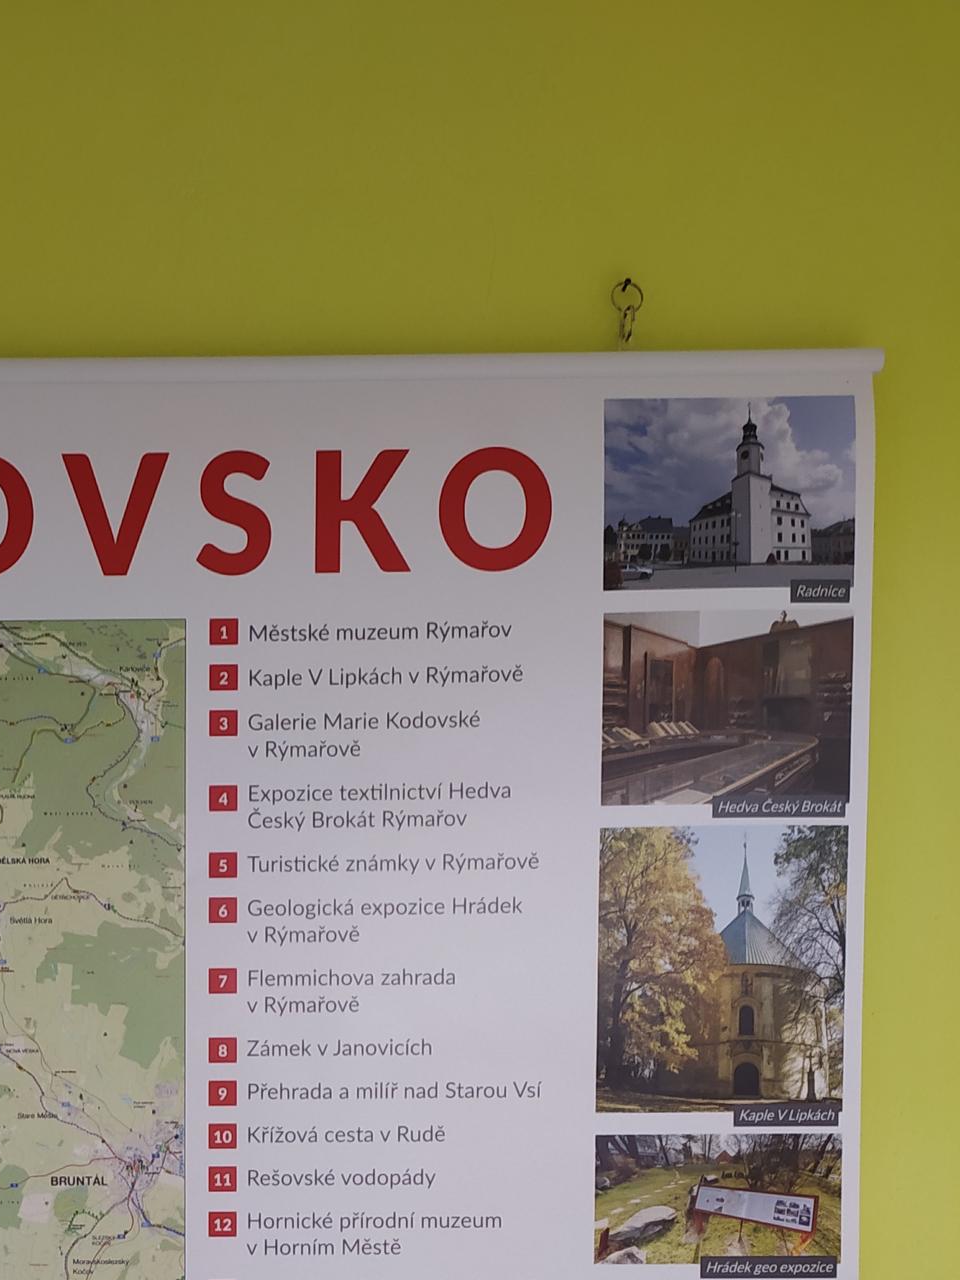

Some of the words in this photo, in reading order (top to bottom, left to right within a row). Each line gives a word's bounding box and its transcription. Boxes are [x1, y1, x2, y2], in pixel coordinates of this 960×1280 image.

[797, 585, 845, 597] Radnice
[250, 624, 329, 641] Městské
[337, 627, 418, 640] muzeum
[427, 621, 511, 642] Rýmařov
[250, 669, 302, 690] Kaple
[309, 669, 322, 685] V
[330, 667, 401, 688] Lipkách
[409, 672, 419, 684] v
[427, 665, 523, 687] Rýmařově
[248, 713, 316, 731] Galerie
[324, 712, 378, 729] Marie
[387, 710, 480, 729] Kodovské
[249, 784, 332, 805] Expozice
[340, 783, 442, 800] textilnictví
[450, 782, 510, 799] Hedva
[719, 801, 758, 814] Hedva
[762, 800, 800, 815] Český
[801, 801, 842, 814] Brokát
[248, 808, 305, 832] Český
[313, 811, 375, 828] Brokát
[383, 810, 467, 831] Rýmařov
[247, 855, 339, 872] Turistické
[346, 854, 419, 874] známky
[426, 859, 435, 870] v
[443, 853, 539, 874] Rýmařově
[248, 899, 353, 920] Geologická
[361, 898, 444, 918] expozice
[453, 897, 521, 914] Hrádek
[249, 969, 373, 986] Flemmichova
[382, 968, 455, 985] zahrada
[247, 1040, 311, 1056] Zámek
[318, 1044, 328, 1056] v
[333, 1039, 431, 1056] Janovicích
[248, 1083, 332, 1100] Přehrada
[339, 1087, 348, 1099] a
[357, 1082, 398, 1099] milíř
[405, 1082, 438, 1099] nad
[446, 1082, 506, 1098] Starou
[513, 1081, 541, 1098] Vsí
[740, 1109, 775, 1123] Kaple
[778, 1110, 789, 1121] V
[789, 1109, 835, 1123] Lipkách
[248, 1126, 317, 1143] Křížová
[325, 1127, 373, 1142] cesta
[380, 1131, 390, 1142] v
[398, 1125, 445, 1142] Rudě
[50, 1173, 108, 1187] BRUNTÁL
[248, 1169, 335, 1186] Rešovské
[341, 1169, 435, 1189] vodopády
[248, 1212, 332, 1229] Hornické
[340, 1212, 415, 1232] přírodní
[422, 1216, 501, 1228] muzeum
[707, 1262, 752, 1273] Hrádek
[754, 1264, 777, 1275] geo
[780, 1261, 833, 1275] expozice
